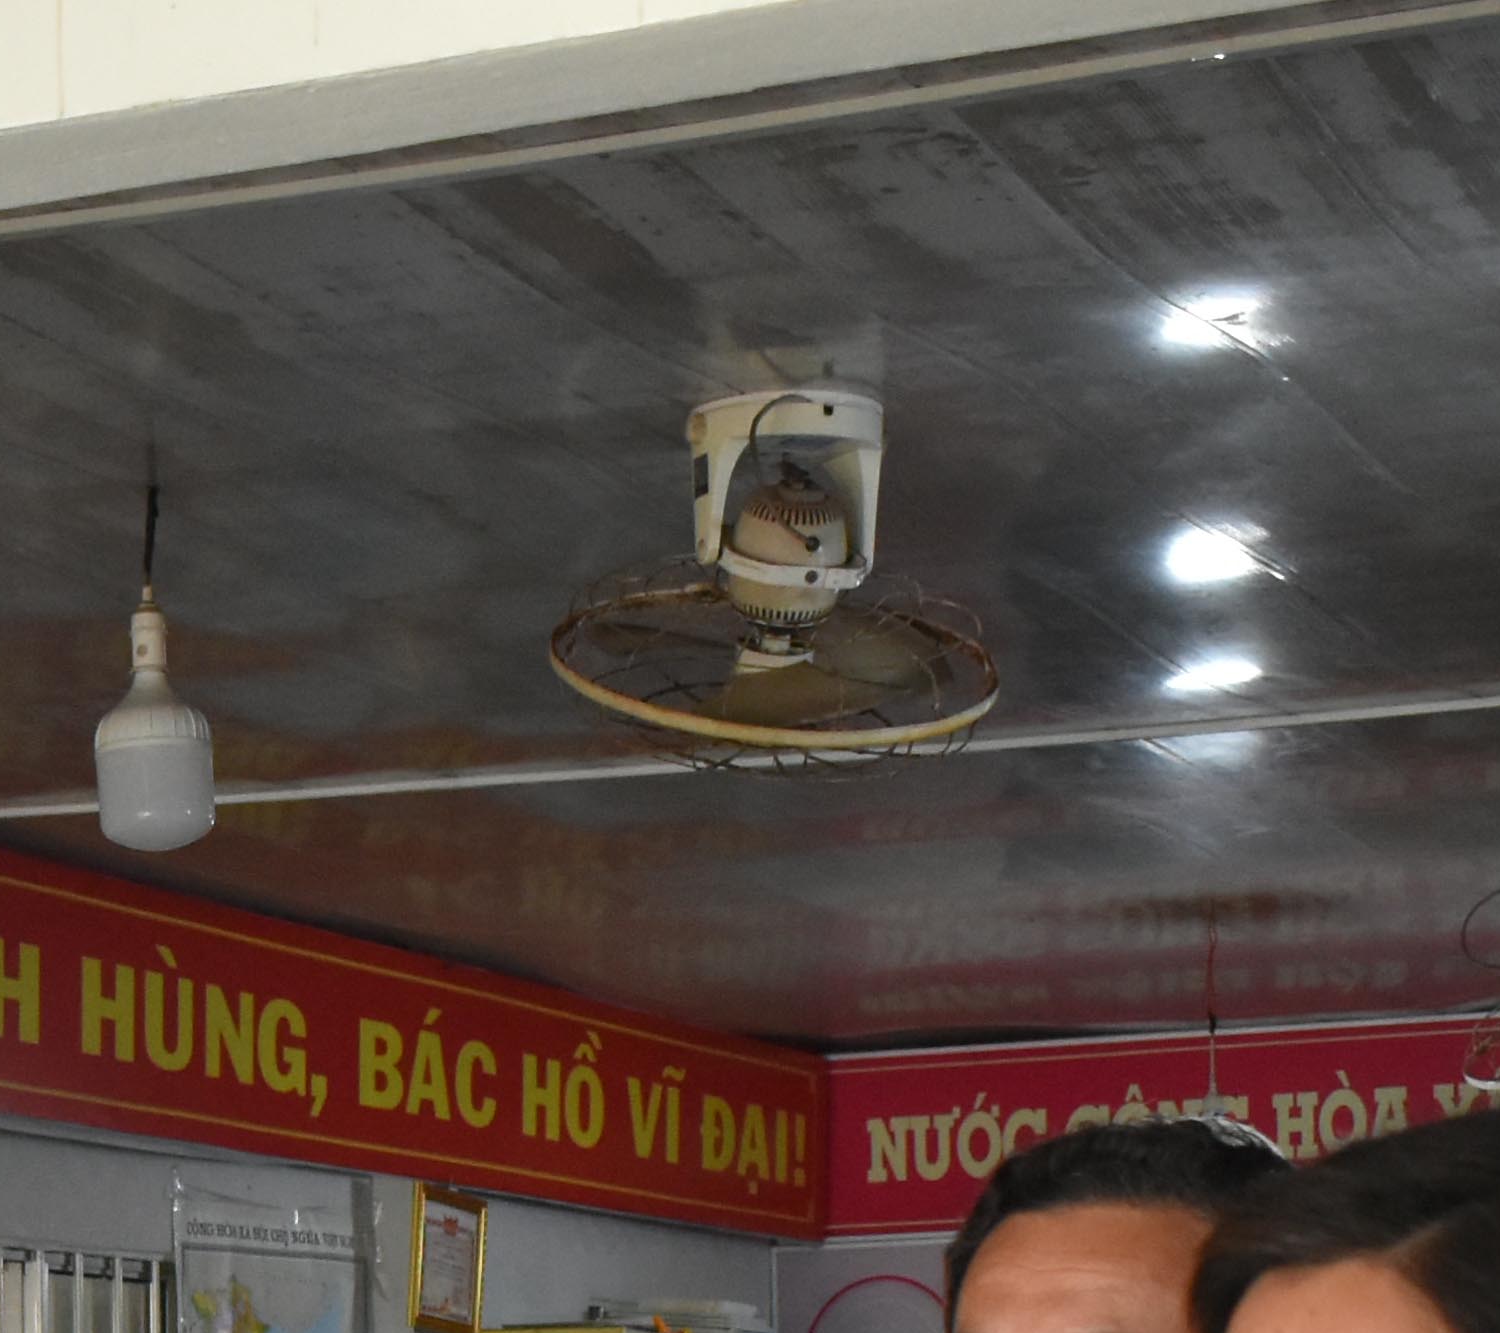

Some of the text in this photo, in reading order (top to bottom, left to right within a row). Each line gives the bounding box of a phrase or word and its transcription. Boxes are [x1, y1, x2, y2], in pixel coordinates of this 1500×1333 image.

[83, 944, 326, 1117] HÙNG,
[358, 1008, 497, 1128] BÁC
[524, 1030, 603, 1147] HỒ
[628, 1066, 685, 1163] VĨ
[700, 1097, 808, 1194] ĐẠI!
[866, 1093, 1046, 1183] NƯỚC
[1271, 1070, 1408, 1159] HÒA
